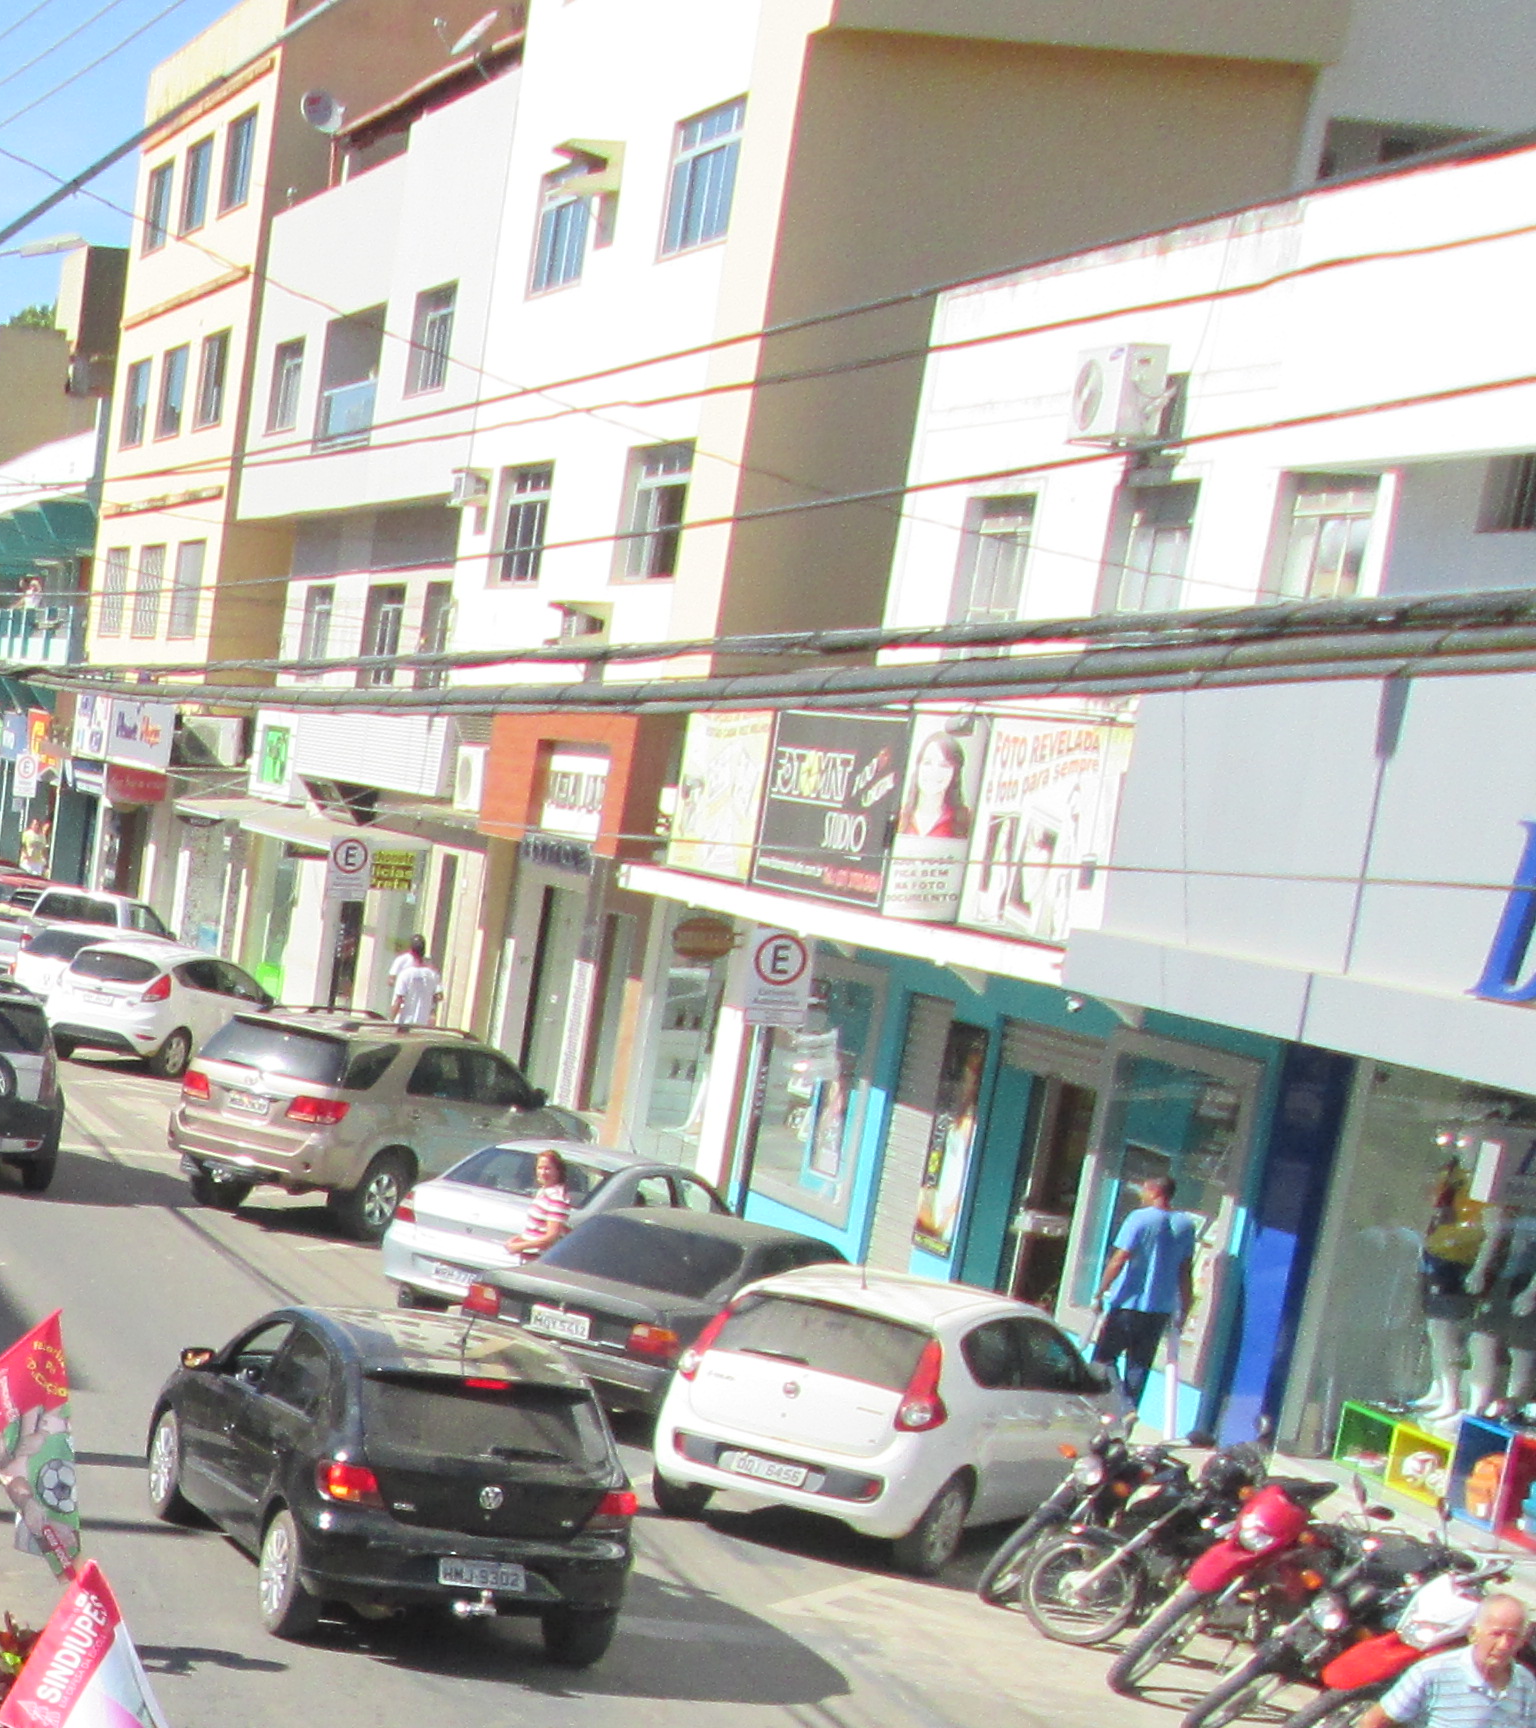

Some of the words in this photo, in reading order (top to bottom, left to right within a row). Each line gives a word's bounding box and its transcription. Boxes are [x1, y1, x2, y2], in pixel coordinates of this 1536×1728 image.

[344, 847, 358, 866] E
[771, 944, 791, 975] E
[37, 1594, 108, 1706] SINDIUPES
